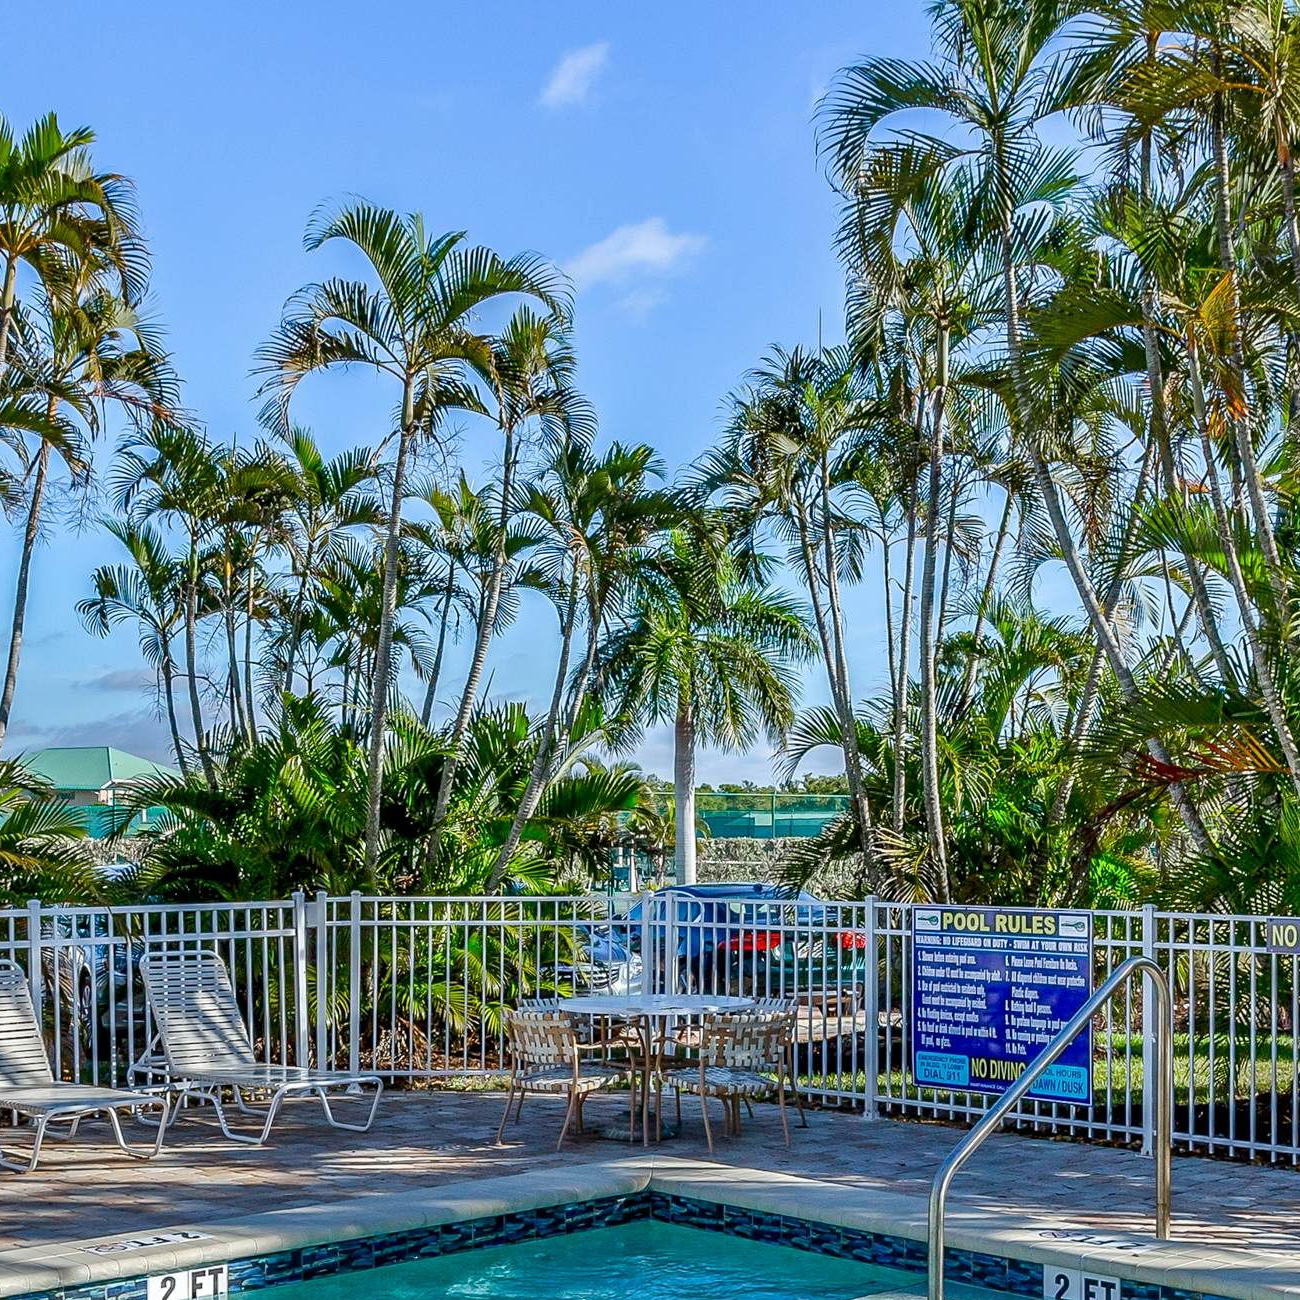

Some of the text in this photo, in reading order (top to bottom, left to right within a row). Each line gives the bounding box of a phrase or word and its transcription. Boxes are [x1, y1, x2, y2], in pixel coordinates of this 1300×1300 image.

[943, 912, 1056, 935] POOL RULES
[916, 935, 941, 944] WARNING:
[943, 936, 950, 945] NO
[952, 937, 981, 947] LIFEGUARD
[983, 938, 991, 947] ON
[993, 939, 1008, 948] DUTY
[1013, 940, 1029, 949] SWIM
[1031, 941, 1039, 949] AT
[1041, 941, 1056, 951] YOUR
[1058, 942, 1072, 951] OWN
[1074, 942, 1088, 952] RISK
[1272, 925, 1297, 947] NO
[924, 1068, 960, 1080] DIAL 911
[971, 1058, 987, 1078] NO
[1056, 1070, 1081, 1078] HOURS
[1063, 1081, 1084, 1094] DUSK
[1055, 1274, 1069, 1300] 2
